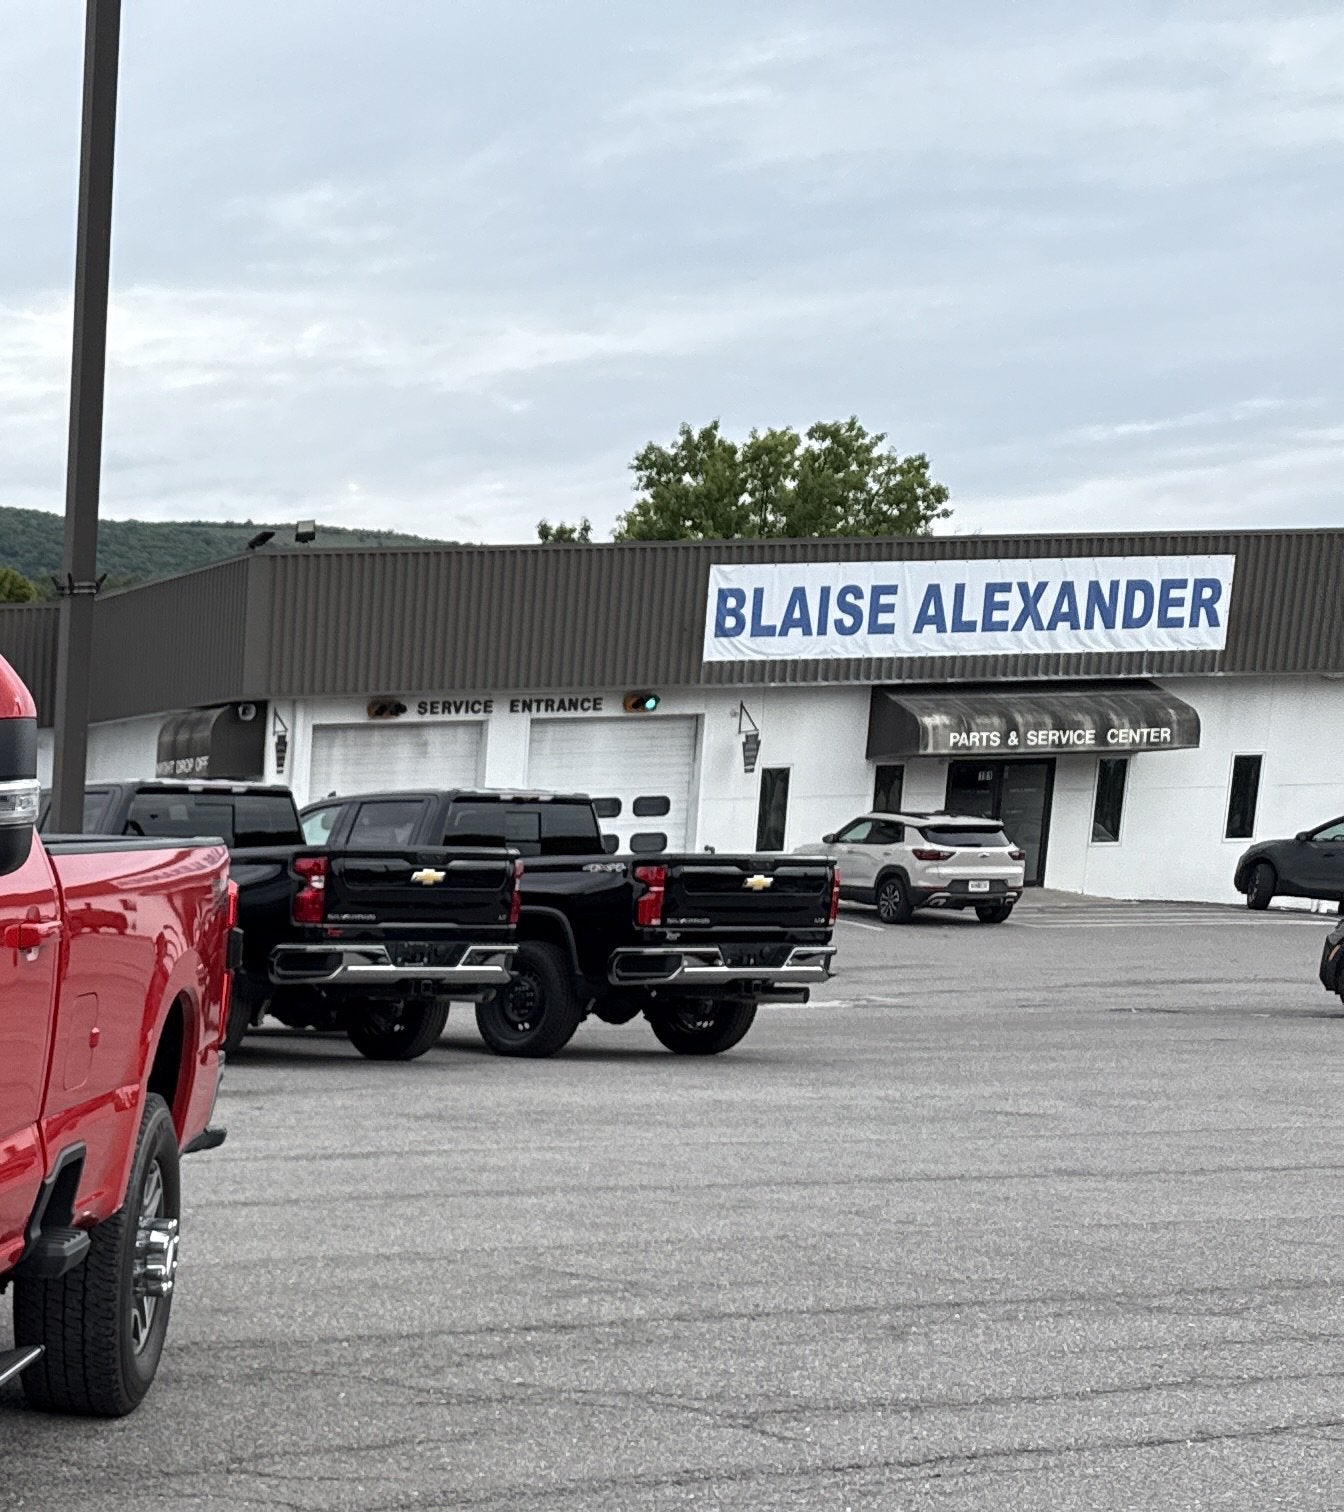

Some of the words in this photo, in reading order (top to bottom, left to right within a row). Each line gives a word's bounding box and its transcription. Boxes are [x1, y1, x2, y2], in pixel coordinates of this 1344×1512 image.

[714, 584, 899, 638] BLAISE
[912, 578, 1222, 634] ALEXANDER
[417, 700, 493, 716] SERVICE
[509, 697, 604, 713] ENTRANCE
[949, 731, 1001, 747] PARTS
[1007, 731, 1019, 746] &
[1027, 729, 1096, 745] SERVICE
[1107, 727, 1171, 743] CENTER
